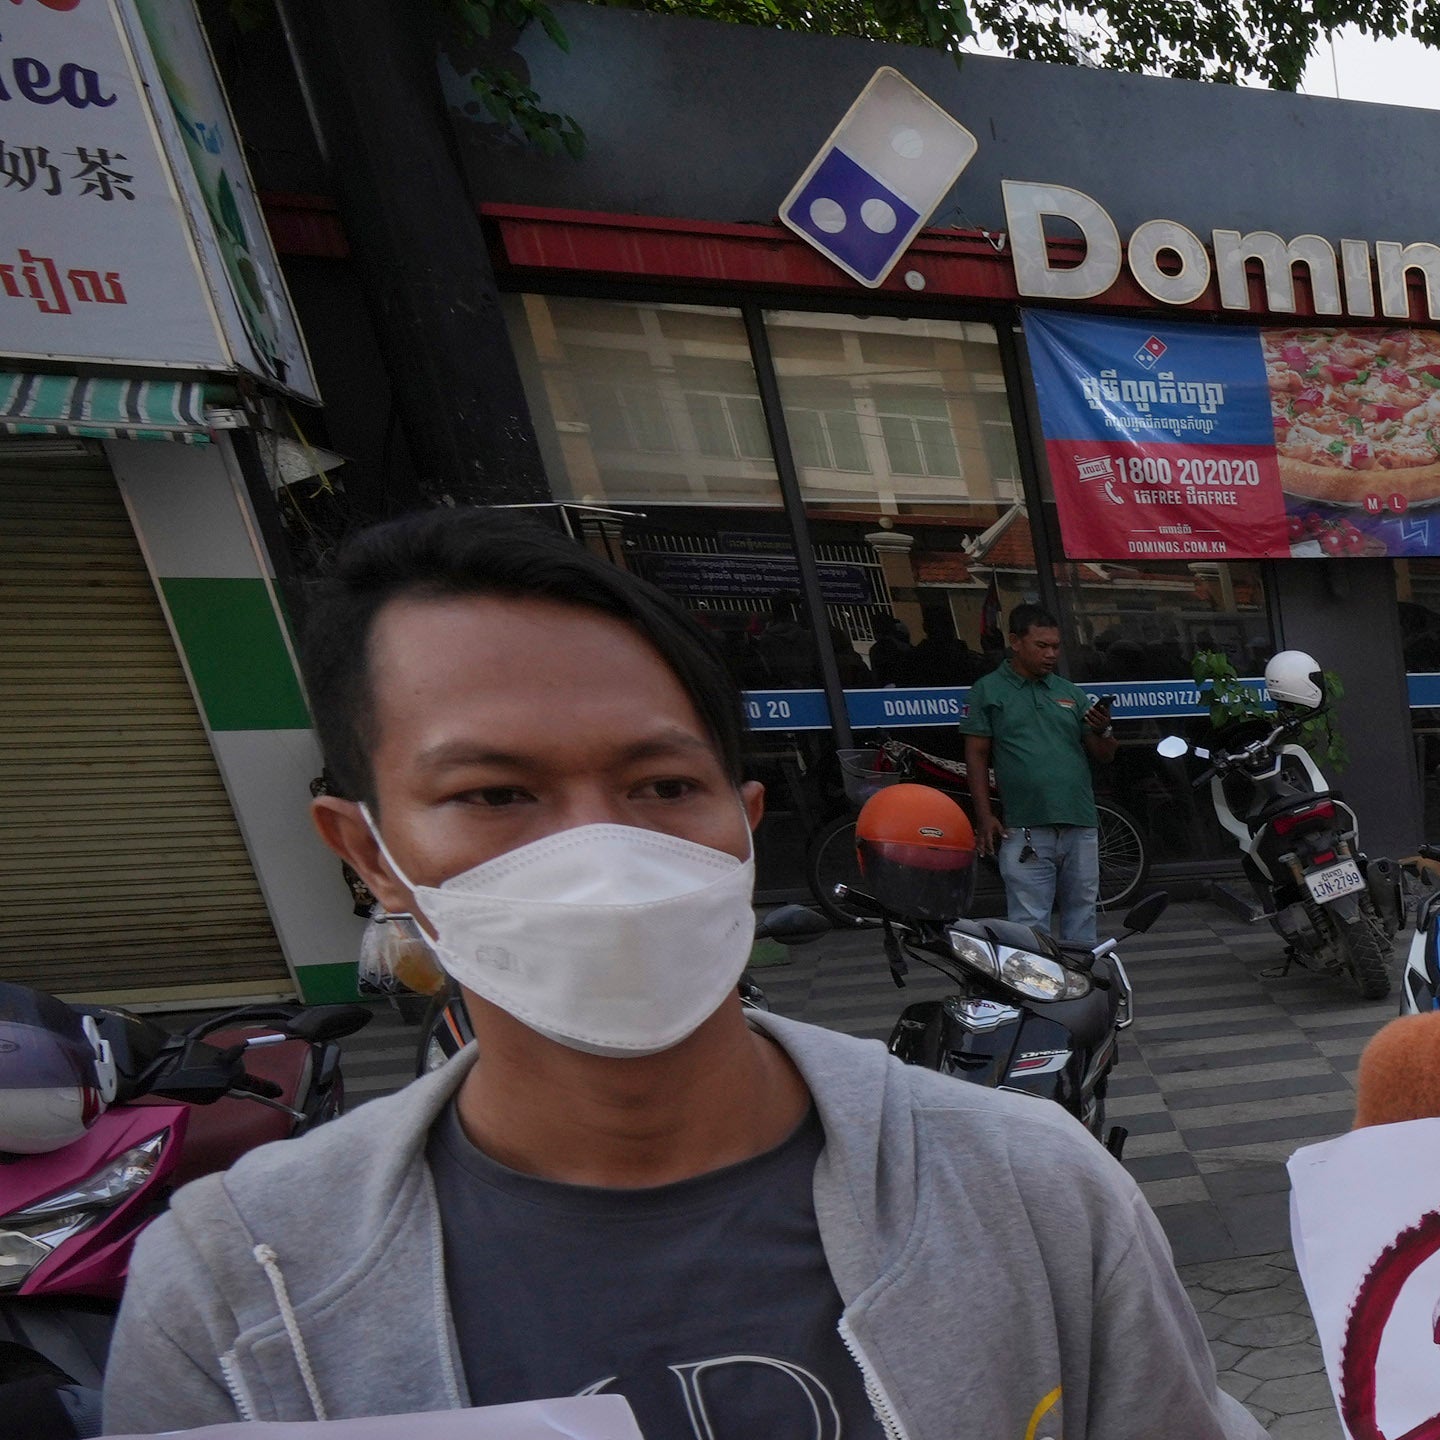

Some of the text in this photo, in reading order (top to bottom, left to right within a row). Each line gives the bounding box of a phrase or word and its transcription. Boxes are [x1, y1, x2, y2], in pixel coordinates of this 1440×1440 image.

[0, 57, 118, 109] ea
[1115, 456, 1260, 486] 1800 202020
[1128, 541, 1227, 553] DOMINOS.COM.KH
[767, 700, 791, 720] 20
